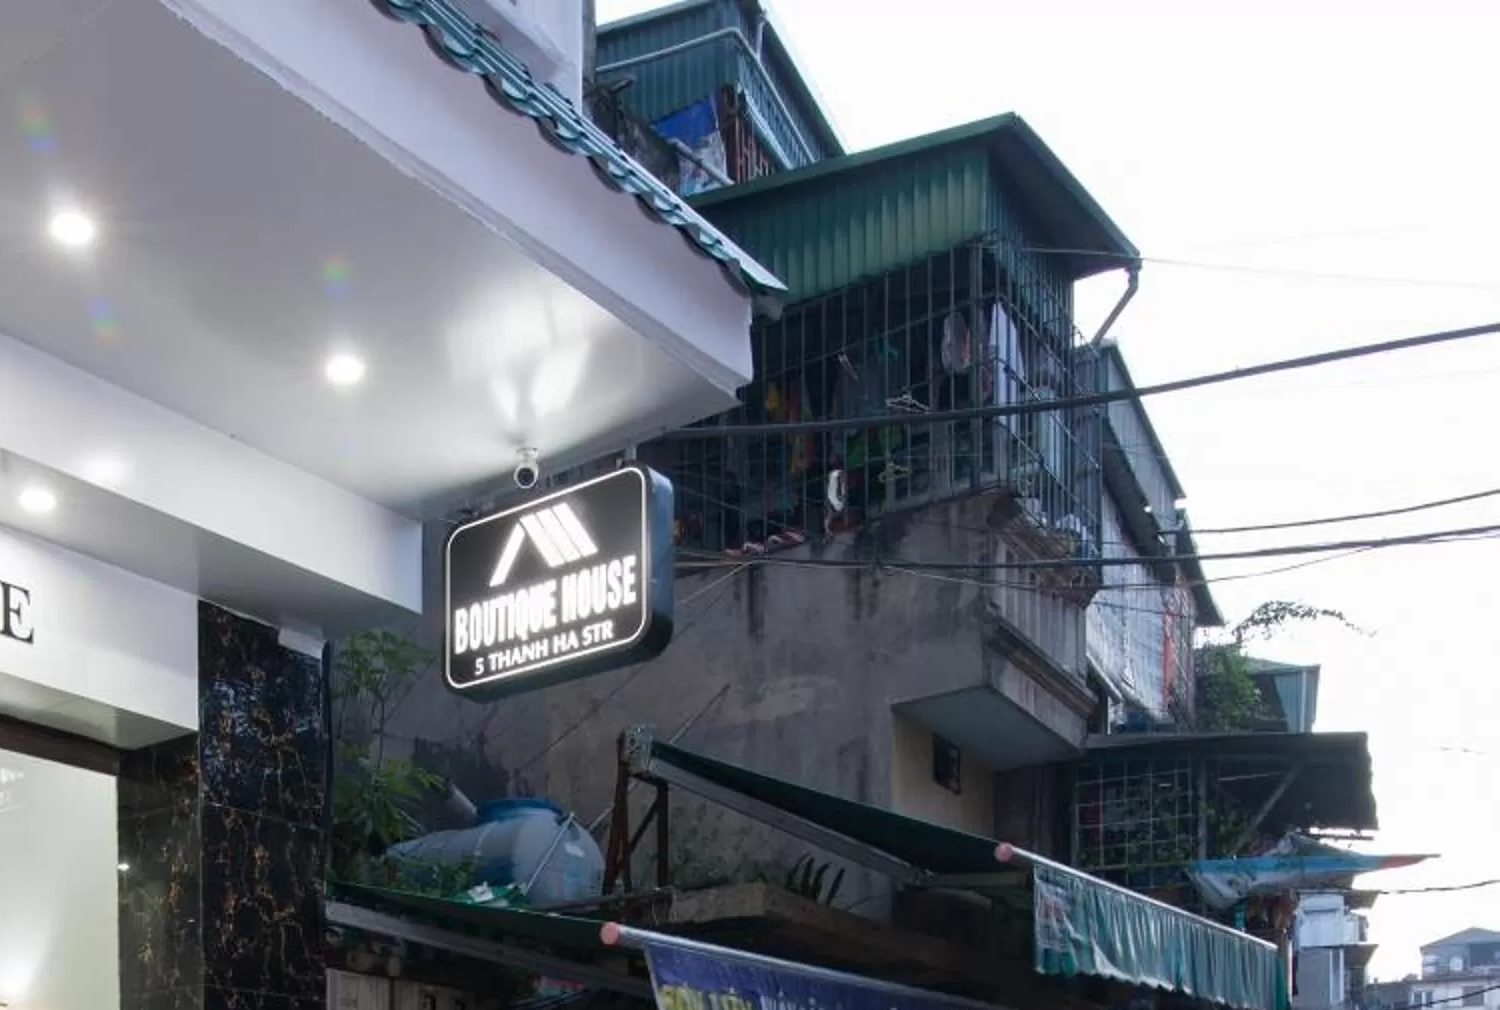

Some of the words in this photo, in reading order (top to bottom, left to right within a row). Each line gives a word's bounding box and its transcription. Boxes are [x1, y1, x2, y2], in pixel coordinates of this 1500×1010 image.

[454, 580, 557, 654] BOUTIQUE
[561, 554, 637, 623] HOUSE
[474, 657, 485, 676] 5
[489, 637, 549, 673] THANH
[552, 633, 579, 654] HA
[582, 620, 614, 648] STR
